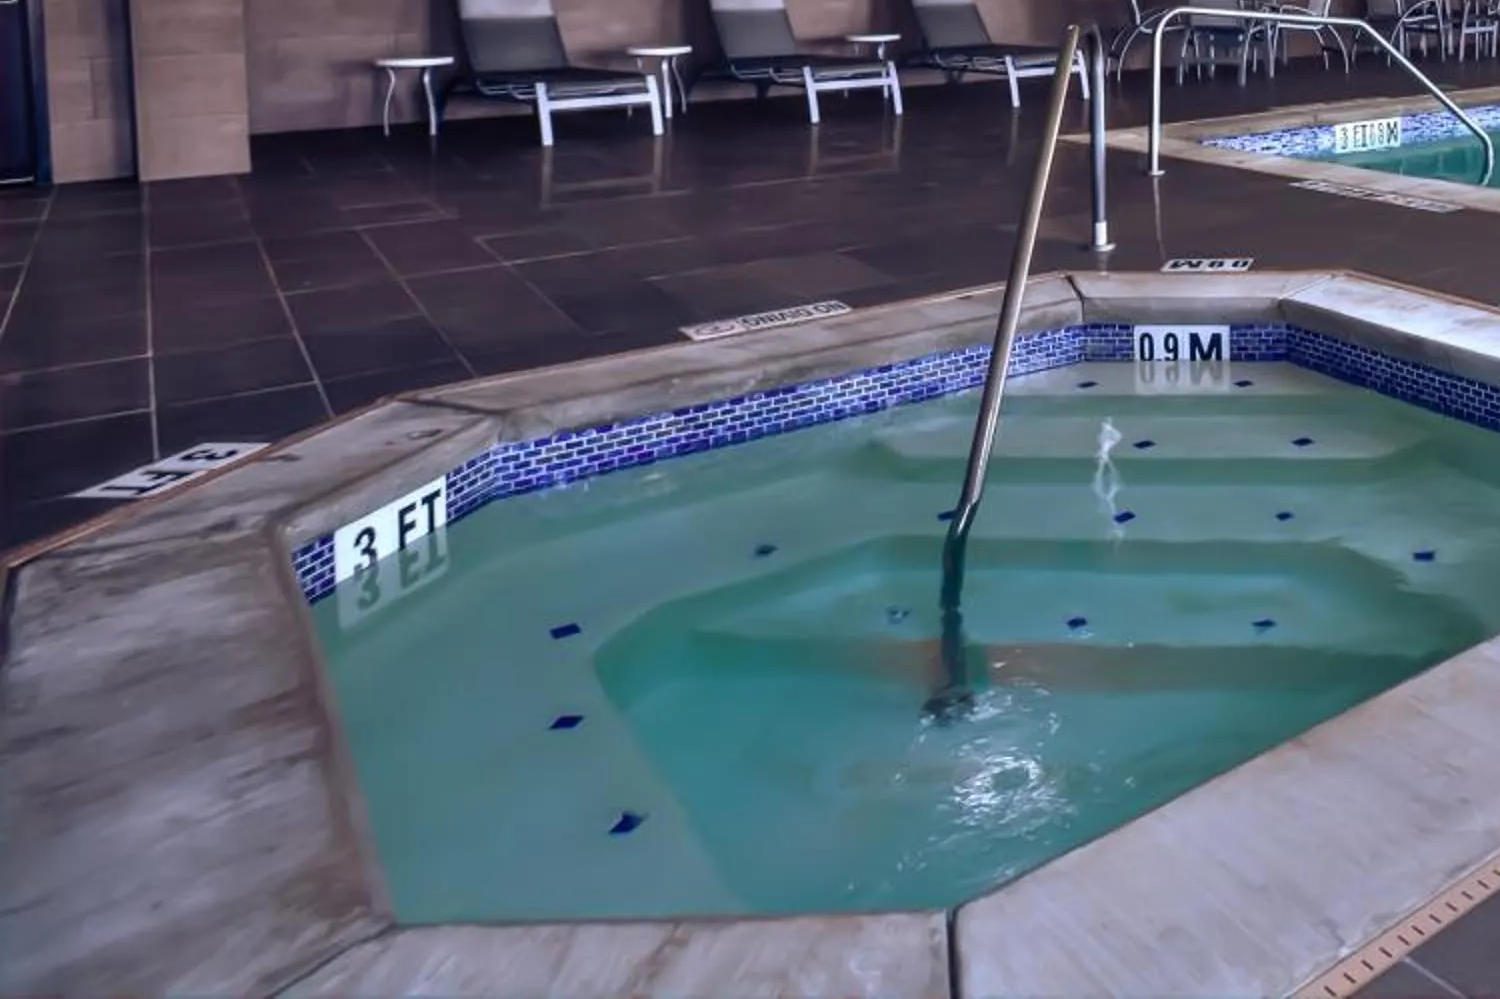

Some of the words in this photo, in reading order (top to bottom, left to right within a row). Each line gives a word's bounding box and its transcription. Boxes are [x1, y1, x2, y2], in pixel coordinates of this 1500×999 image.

[1189, 333, 1222, 361] M
[180, 449, 238, 461] 3
[100, 470, 192, 495] FT
[353, 526, 377, 571] 3
[398, 489, 441, 552] FT
